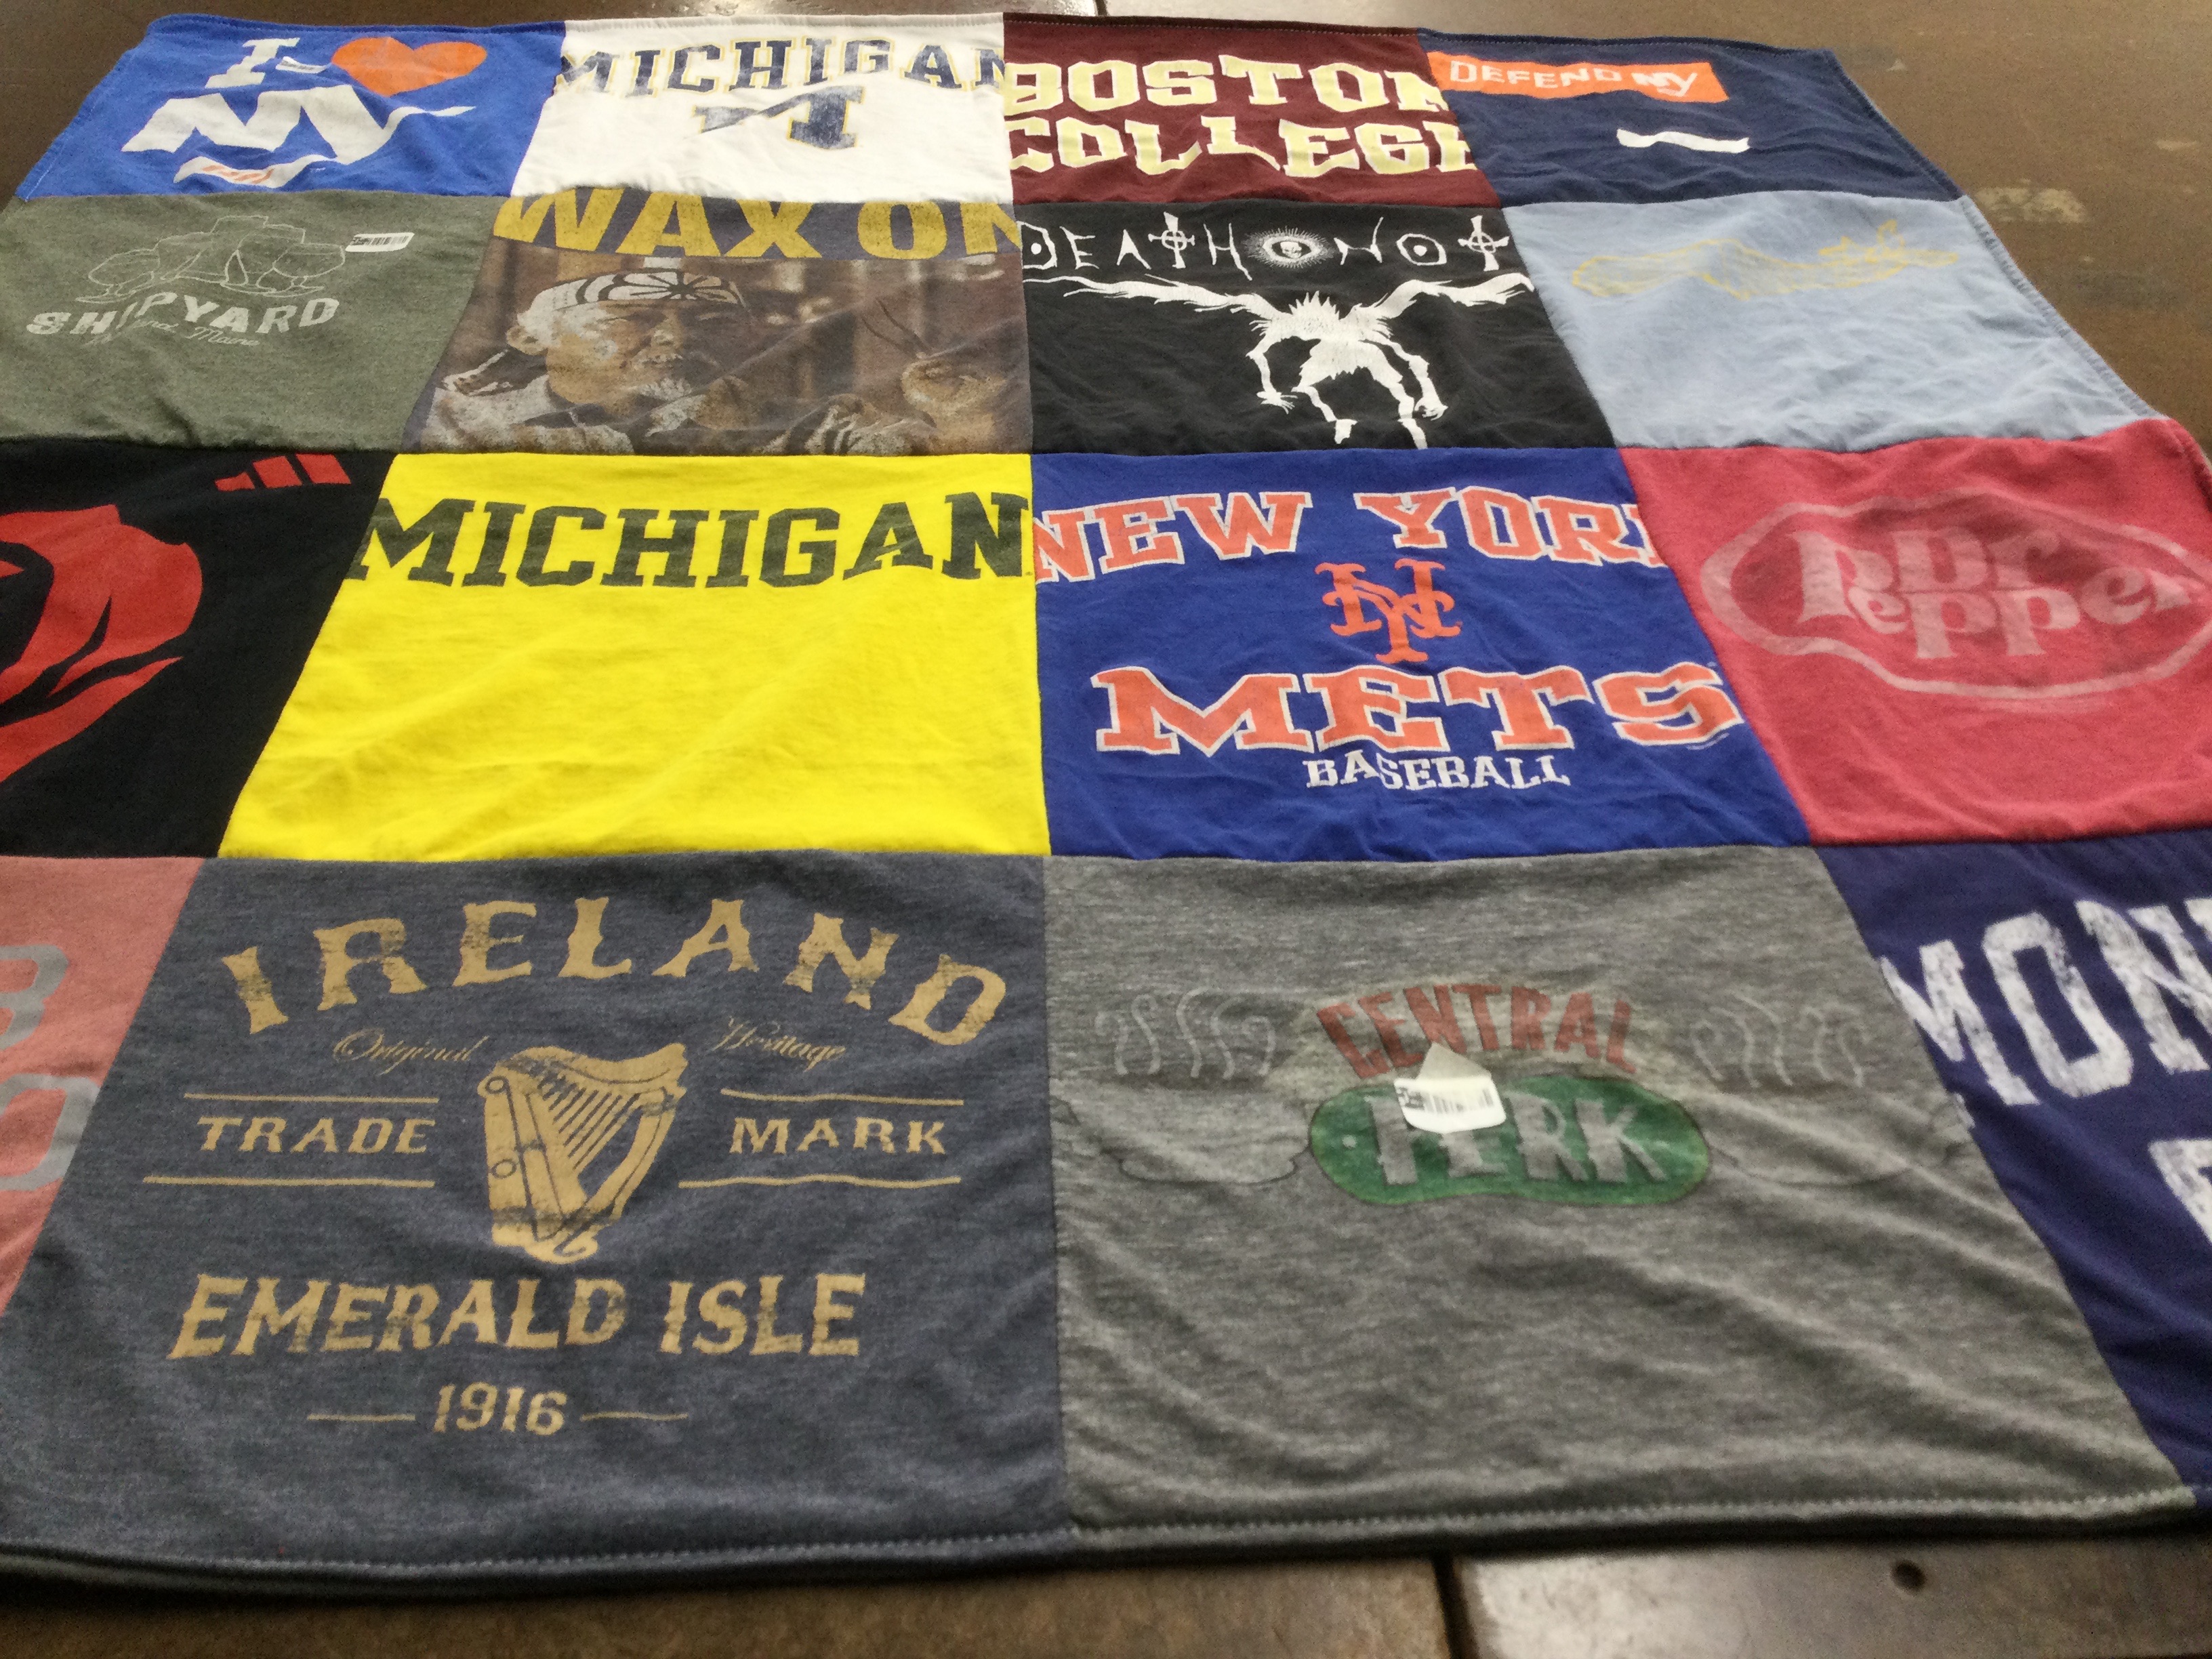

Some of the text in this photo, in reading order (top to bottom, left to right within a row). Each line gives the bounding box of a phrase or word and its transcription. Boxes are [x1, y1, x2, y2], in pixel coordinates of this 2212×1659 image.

[205, 37, 300, 89] I
[1004, 55, 1450, 115] BOSTON
[1450, 60, 1622, 89] DEFEND
[493, 187, 1023, 260] WAX ON
[1016, 211, 1252, 280] DEATH
[26, 291, 340, 336] SHIPYARD
[344, 491, 1029, 588] MICHIGAN
[1033, 491, 1313, 584] NEW
[1090, 661, 1745, 757] METS
[1303, 749, 1572, 791] BASEBALL
[222, 897, 1007, 1046] IRELAND
[333, 1027, 489, 1076] Original
[1316, 983, 1639, 1080] CENTRAL
[197, 1116, 437, 1155] TRADE
[729, 1116, 947, 1155] MARK
[167, 1272, 866, 1359] EMERALD ISLE
[433, 1381, 569, 1437] 1916
